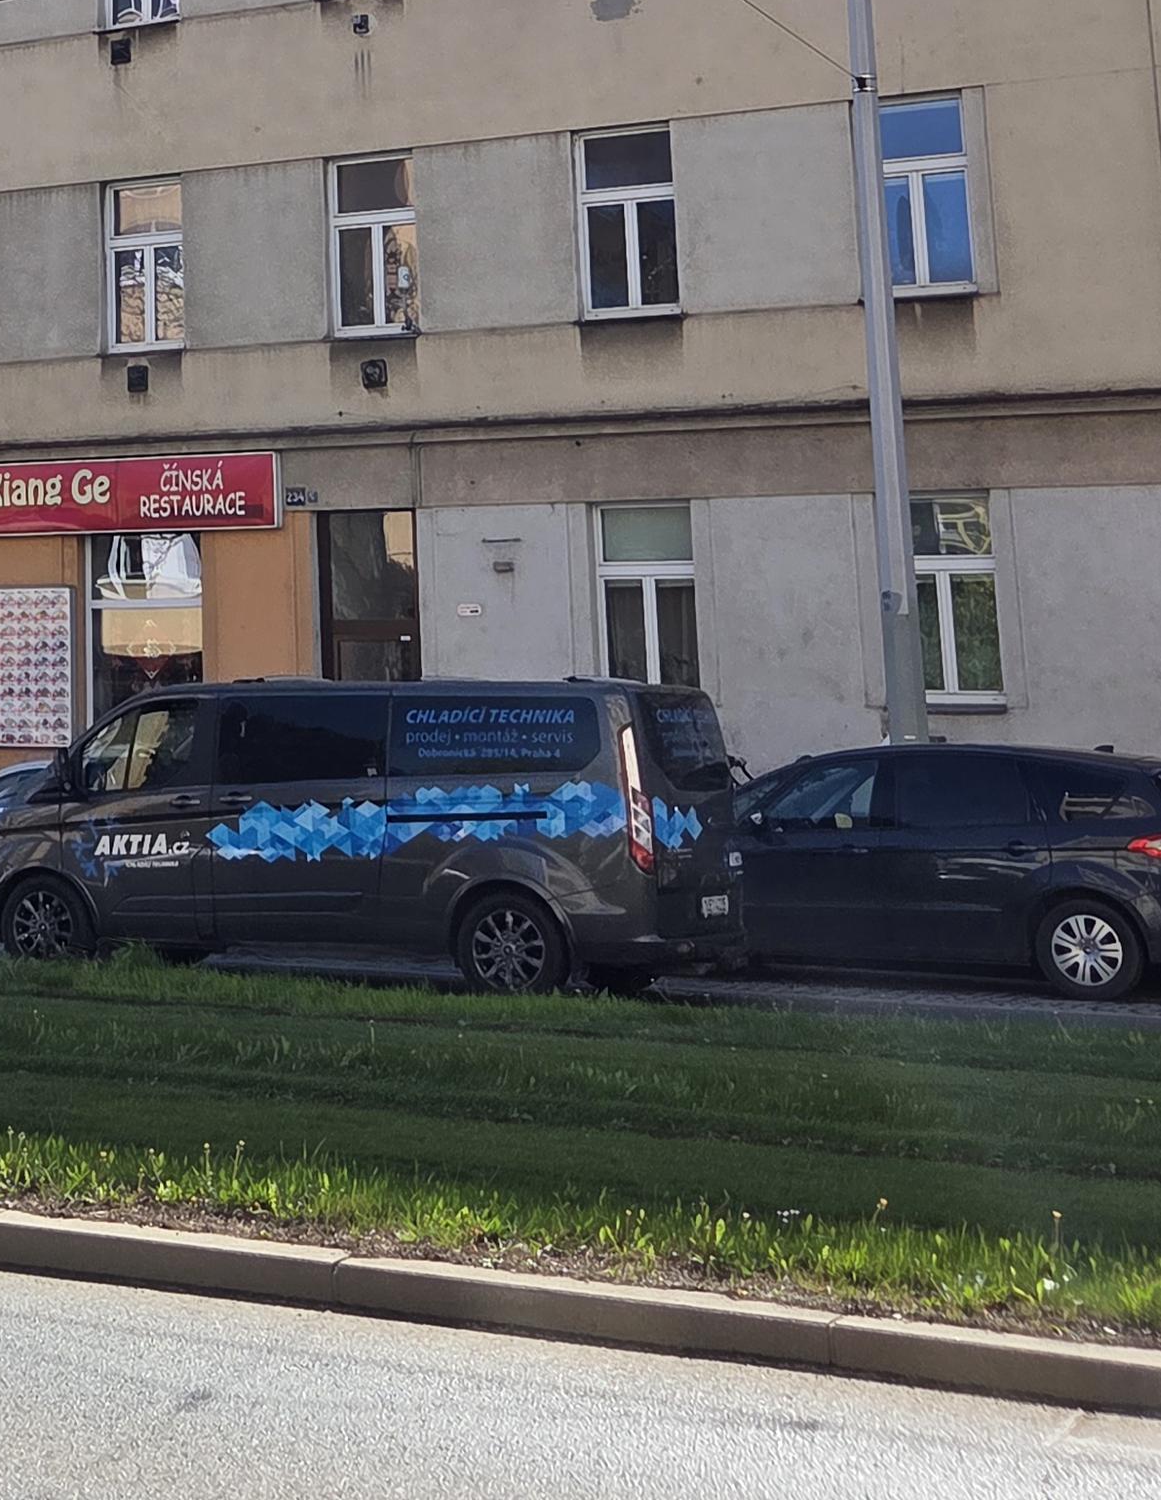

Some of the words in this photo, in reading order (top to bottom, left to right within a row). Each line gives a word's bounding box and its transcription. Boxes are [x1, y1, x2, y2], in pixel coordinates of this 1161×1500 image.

[71, 468, 110, 505] Ge
[160, 460, 224, 492] ČÍNSKÁ
[140, 491, 246, 518] RESTAURACE
[406, 706, 487, 724] CHLADÍCÍ
[489, 708, 575, 724] TECHNIKA
[406, 728, 452, 746] prodej
[463, 728, 519, 744] montáž
[531, 729, 575, 744] servis
[94, 833, 190, 856] AKTIA.cz
